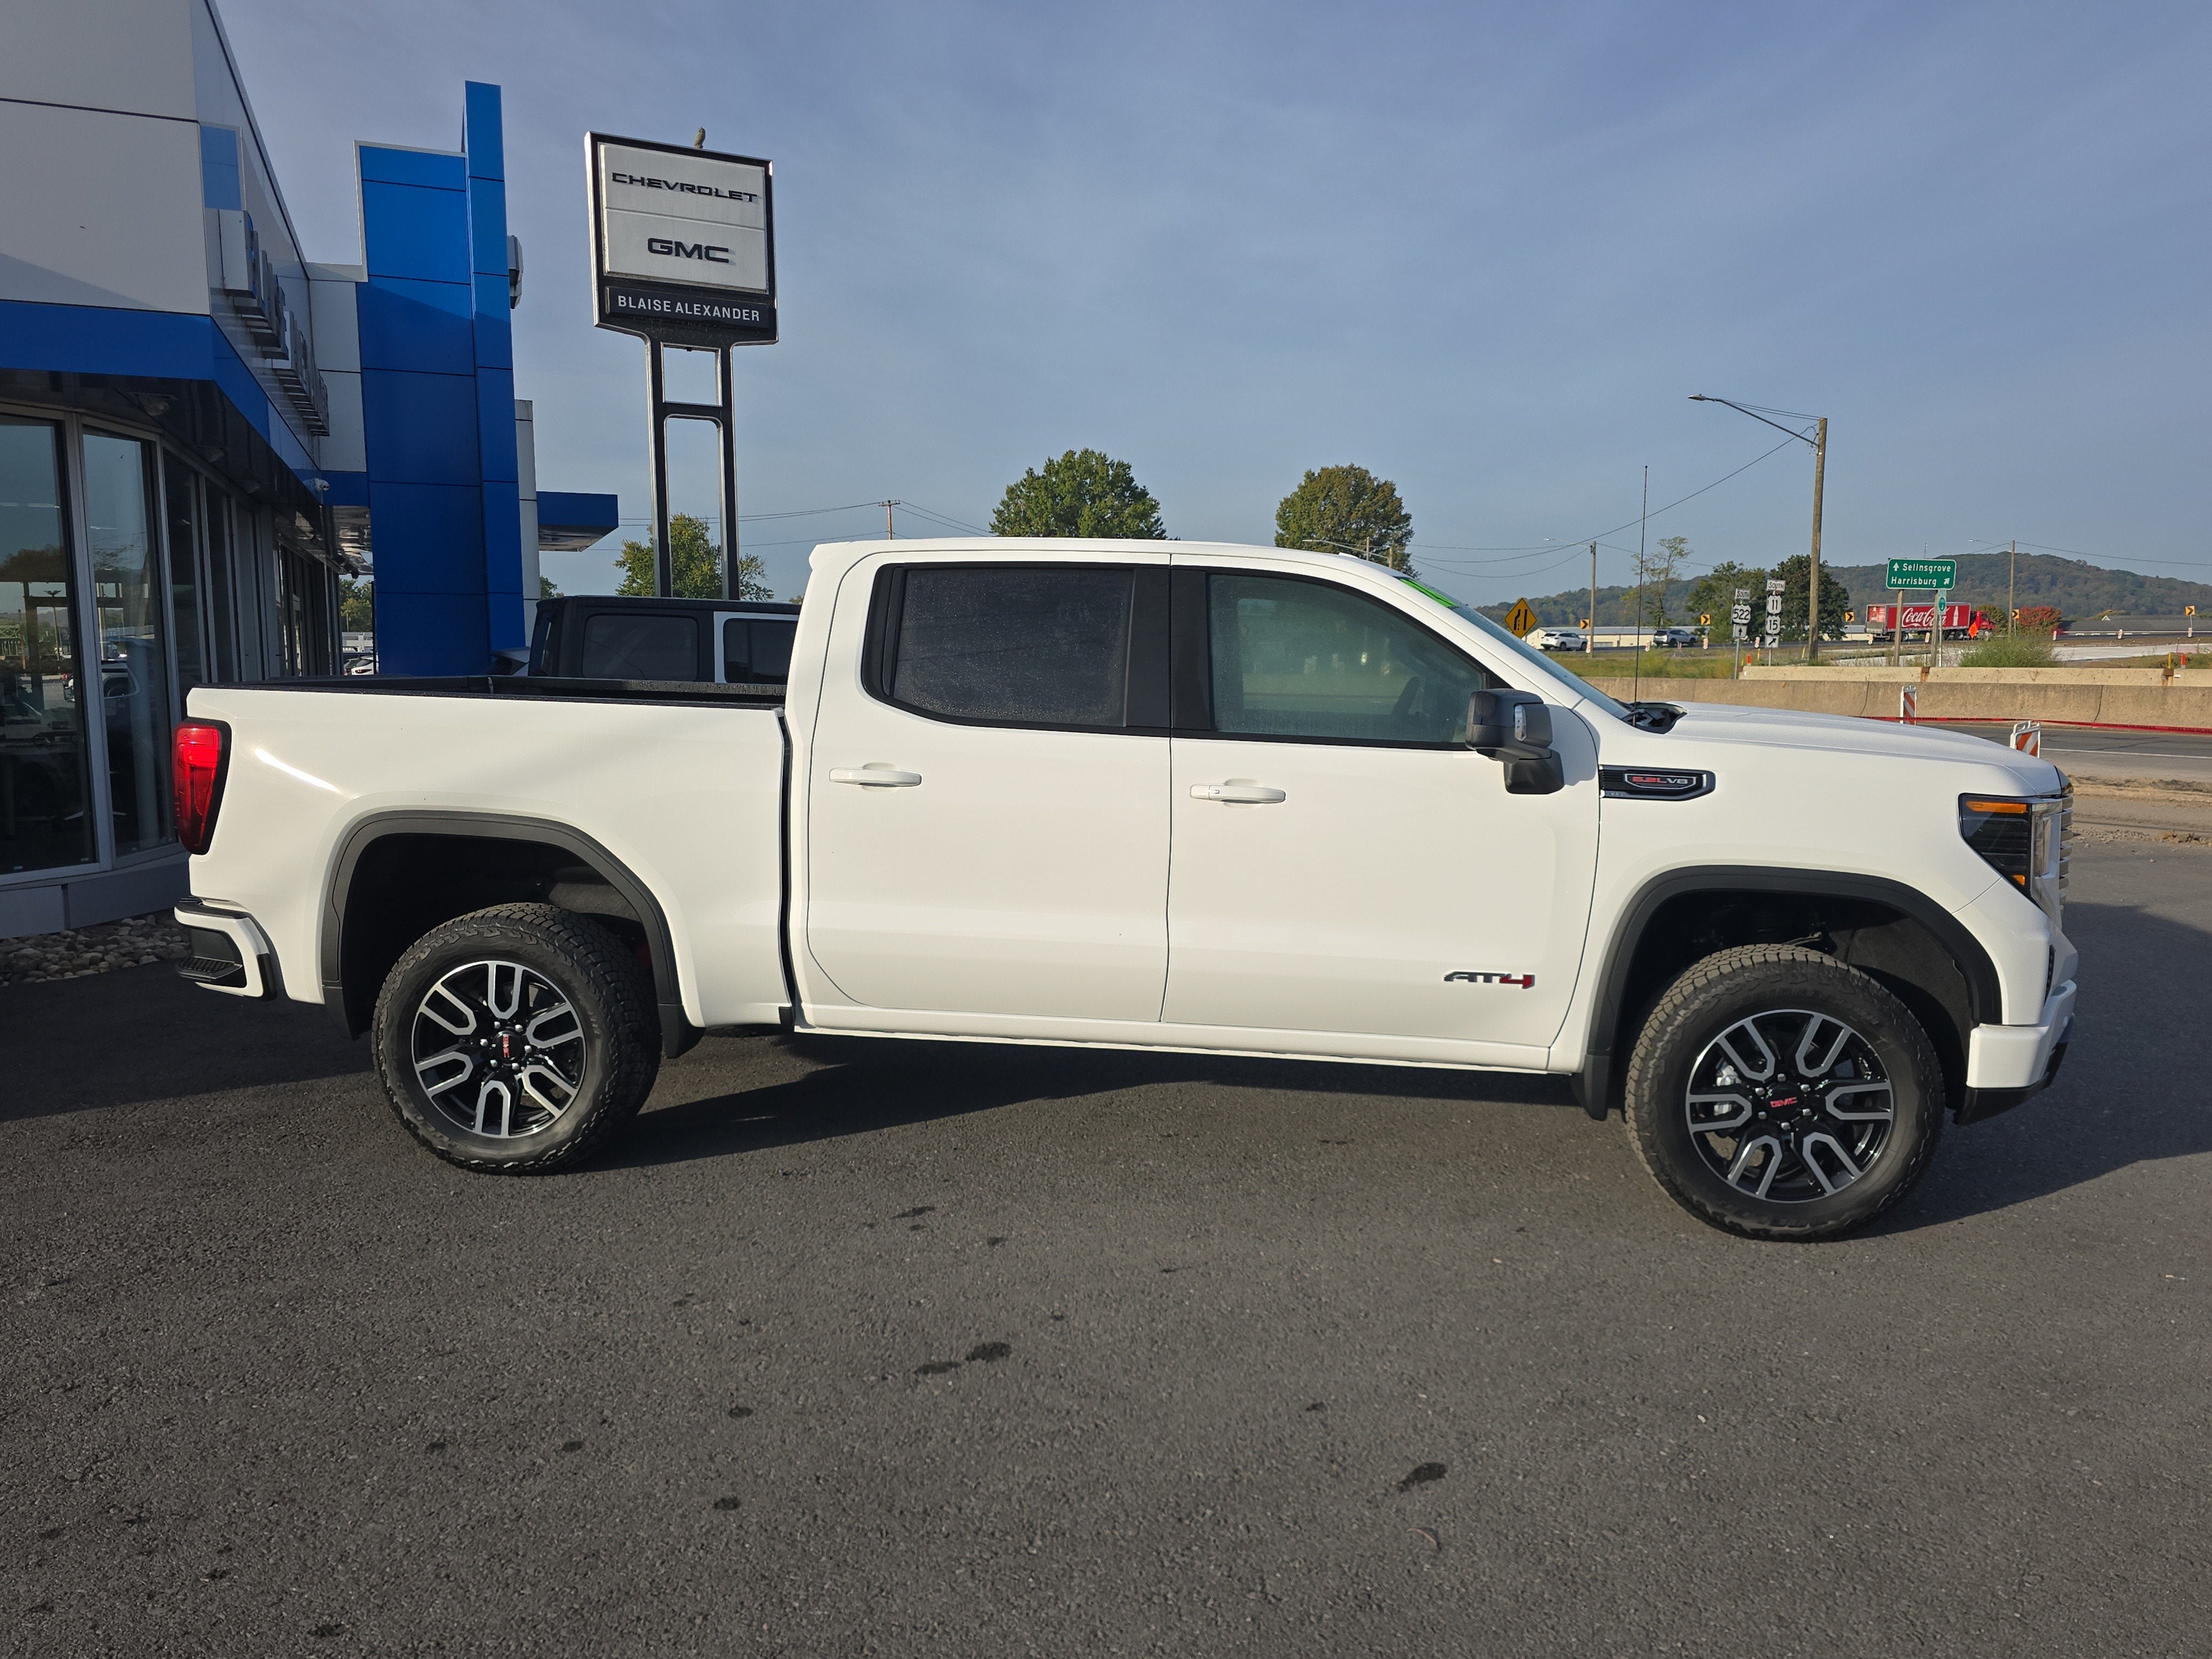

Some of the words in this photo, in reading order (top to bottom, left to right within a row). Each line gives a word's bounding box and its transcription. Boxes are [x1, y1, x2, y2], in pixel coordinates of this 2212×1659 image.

[612, 172, 757, 202] CHEVROLET
[648, 237, 729, 263] GMC
[618, 295, 672, 313] BLAISE
[676, 302, 760, 322] ALEXANDER
[1902, 563, 1951, 574] Selinsgrove
[1891, 576, 1937, 587] Harrisburg
[1772, 599, 1778, 610] 11
[1733, 609, 1750, 620] 522
[1769, 619, 1778, 631] 15
[1444, 971, 1535, 989] AT4
